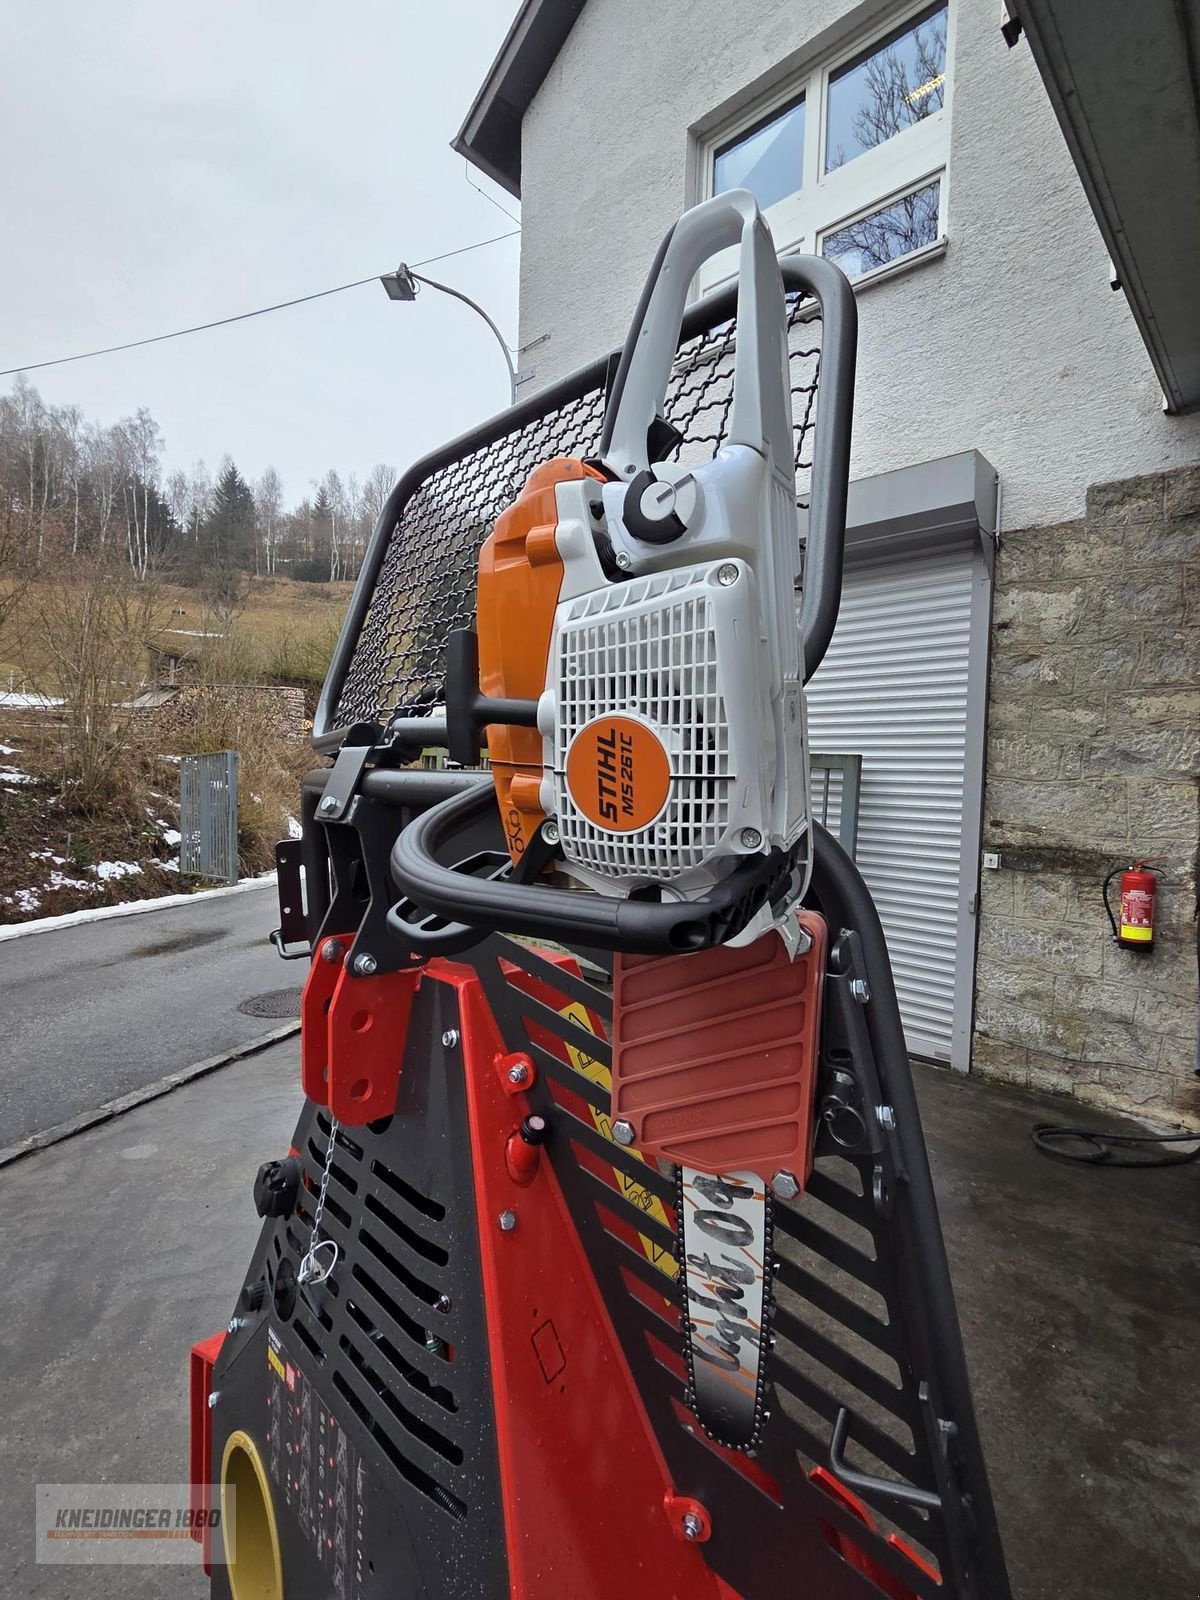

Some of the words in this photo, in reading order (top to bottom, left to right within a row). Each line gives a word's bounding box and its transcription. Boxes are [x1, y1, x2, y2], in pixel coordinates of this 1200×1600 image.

[597, 728, 618, 824] STIHL
[621, 782, 634, 816] MS
[693, 1175, 755, 1247] 04
